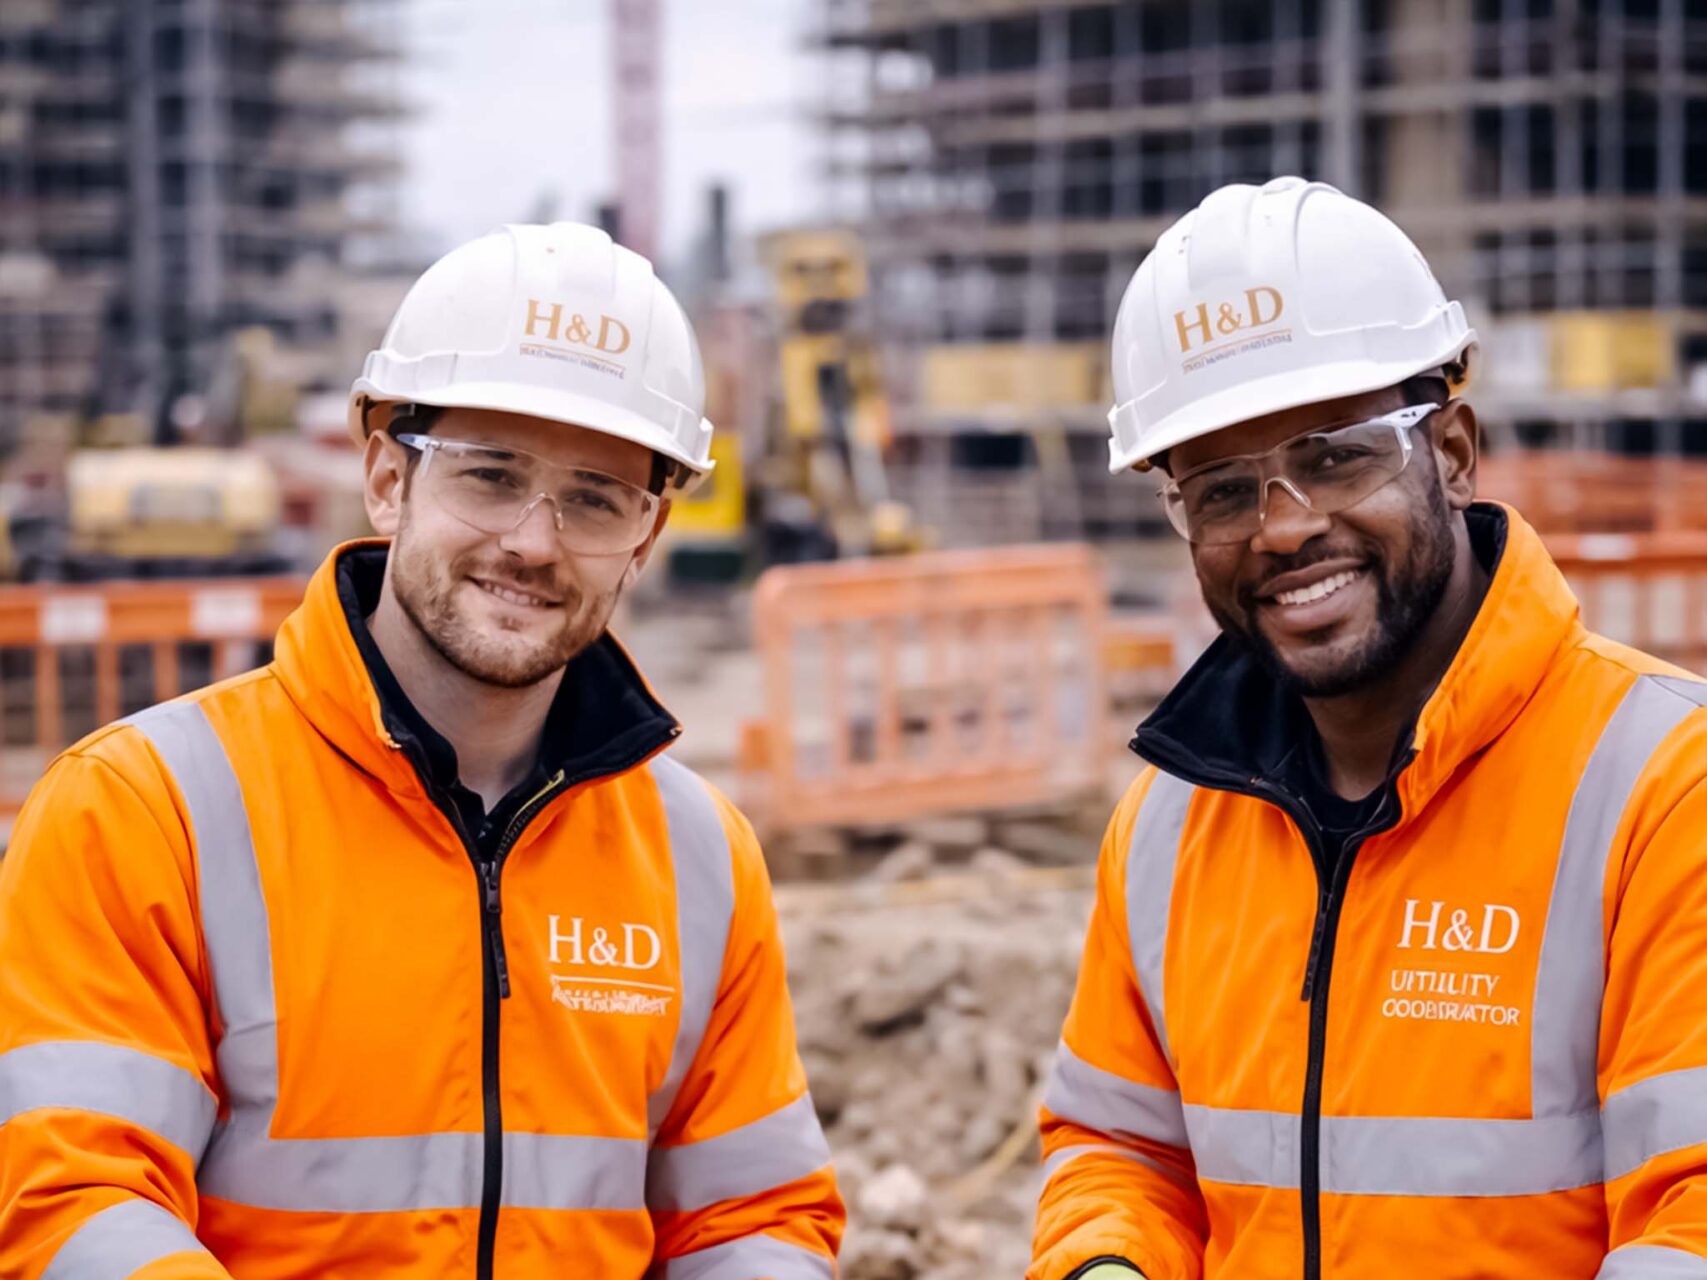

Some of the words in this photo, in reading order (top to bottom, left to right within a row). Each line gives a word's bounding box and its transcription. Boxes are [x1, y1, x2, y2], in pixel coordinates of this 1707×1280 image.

[524, 299, 631, 355] H&D
[1174, 286, 1284, 353] H&D
[548, 914, 661, 970] H&D
[1396, 899, 1521, 954] H&D
